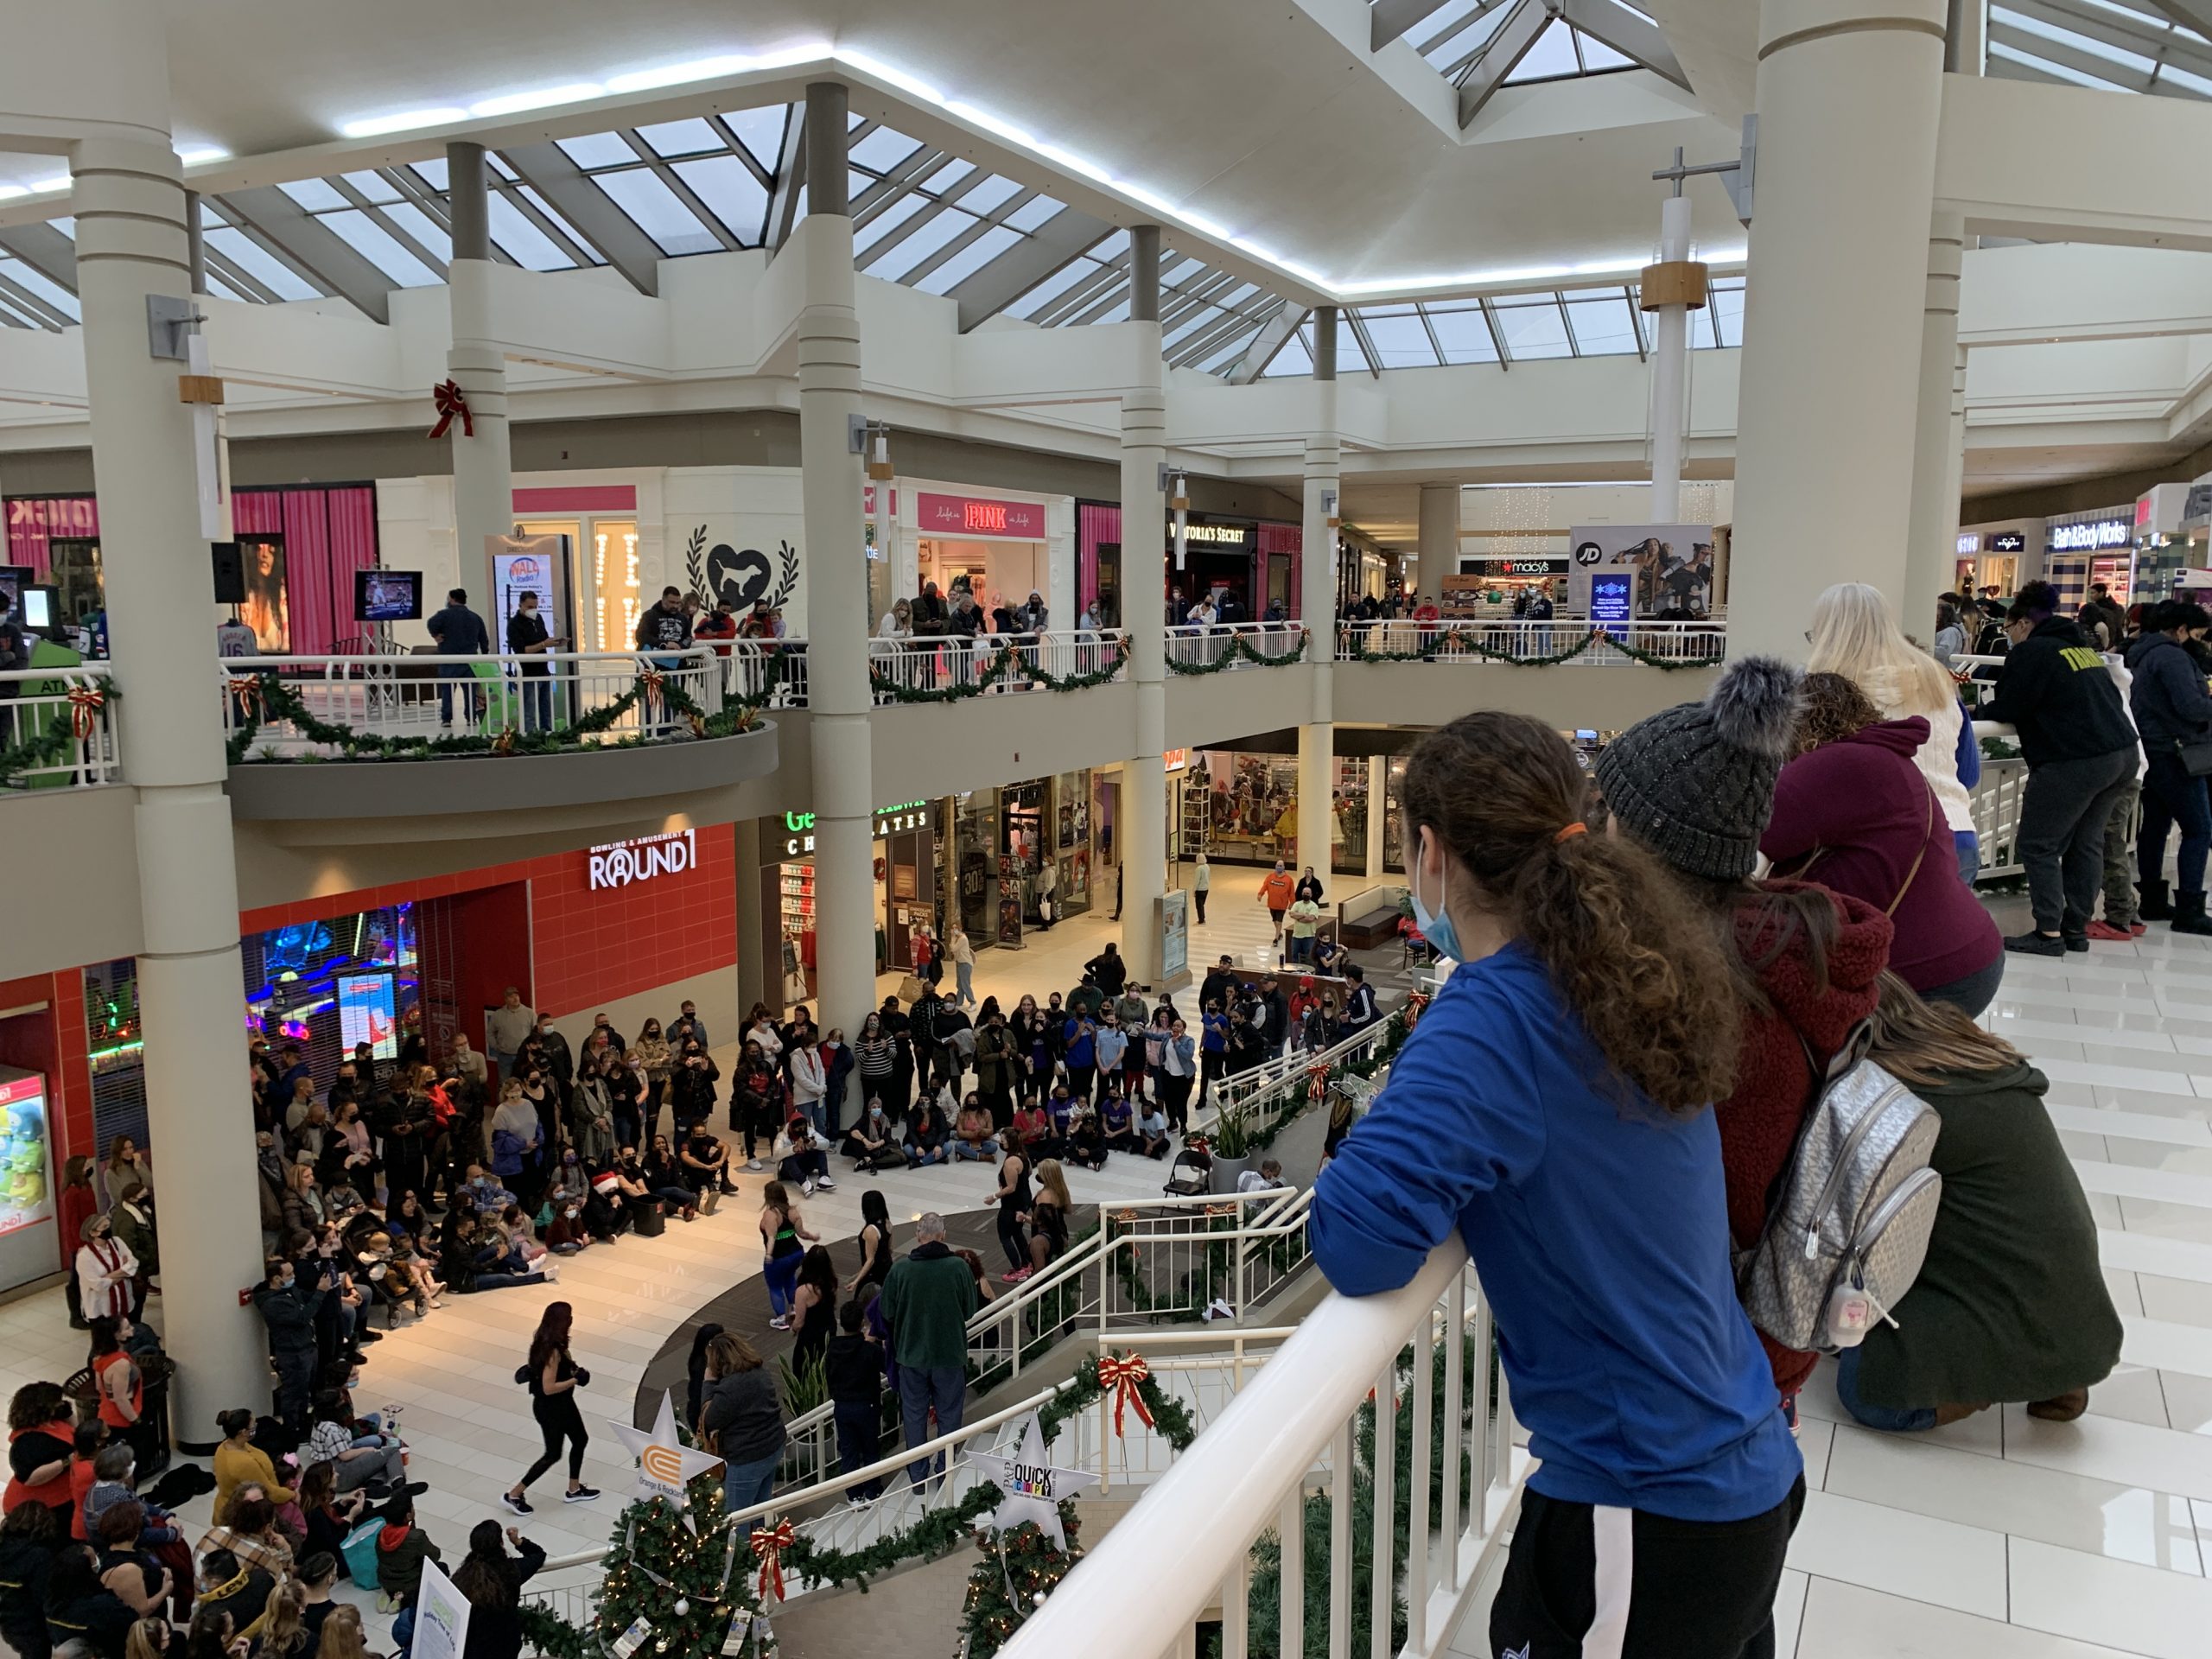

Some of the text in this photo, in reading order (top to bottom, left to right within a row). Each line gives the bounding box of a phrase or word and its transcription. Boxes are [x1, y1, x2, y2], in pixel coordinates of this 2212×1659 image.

[965, 503, 1007, 531] PINK
[1169, 522, 1244, 543] VTORIA'S SECRET
[2054, 526, 2072, 549] Bath
[2078, 524, 2099, 550] Body
[2099, 521, 2126, 546] Works
[1579, 547, 1600, 563] JD
[1513, 562, 1549, 574] macy's
[590, 841, 626, 854] BOWLING
[637, 831, 683, 845] AMUSEMENT
[590, 829, 696, 891] ROUND1
[639, 1477, 657, 1491] Orange
[662, 1484, 686, 1500] Rockland
[1013, 1480, 1051, 1497] COPY
